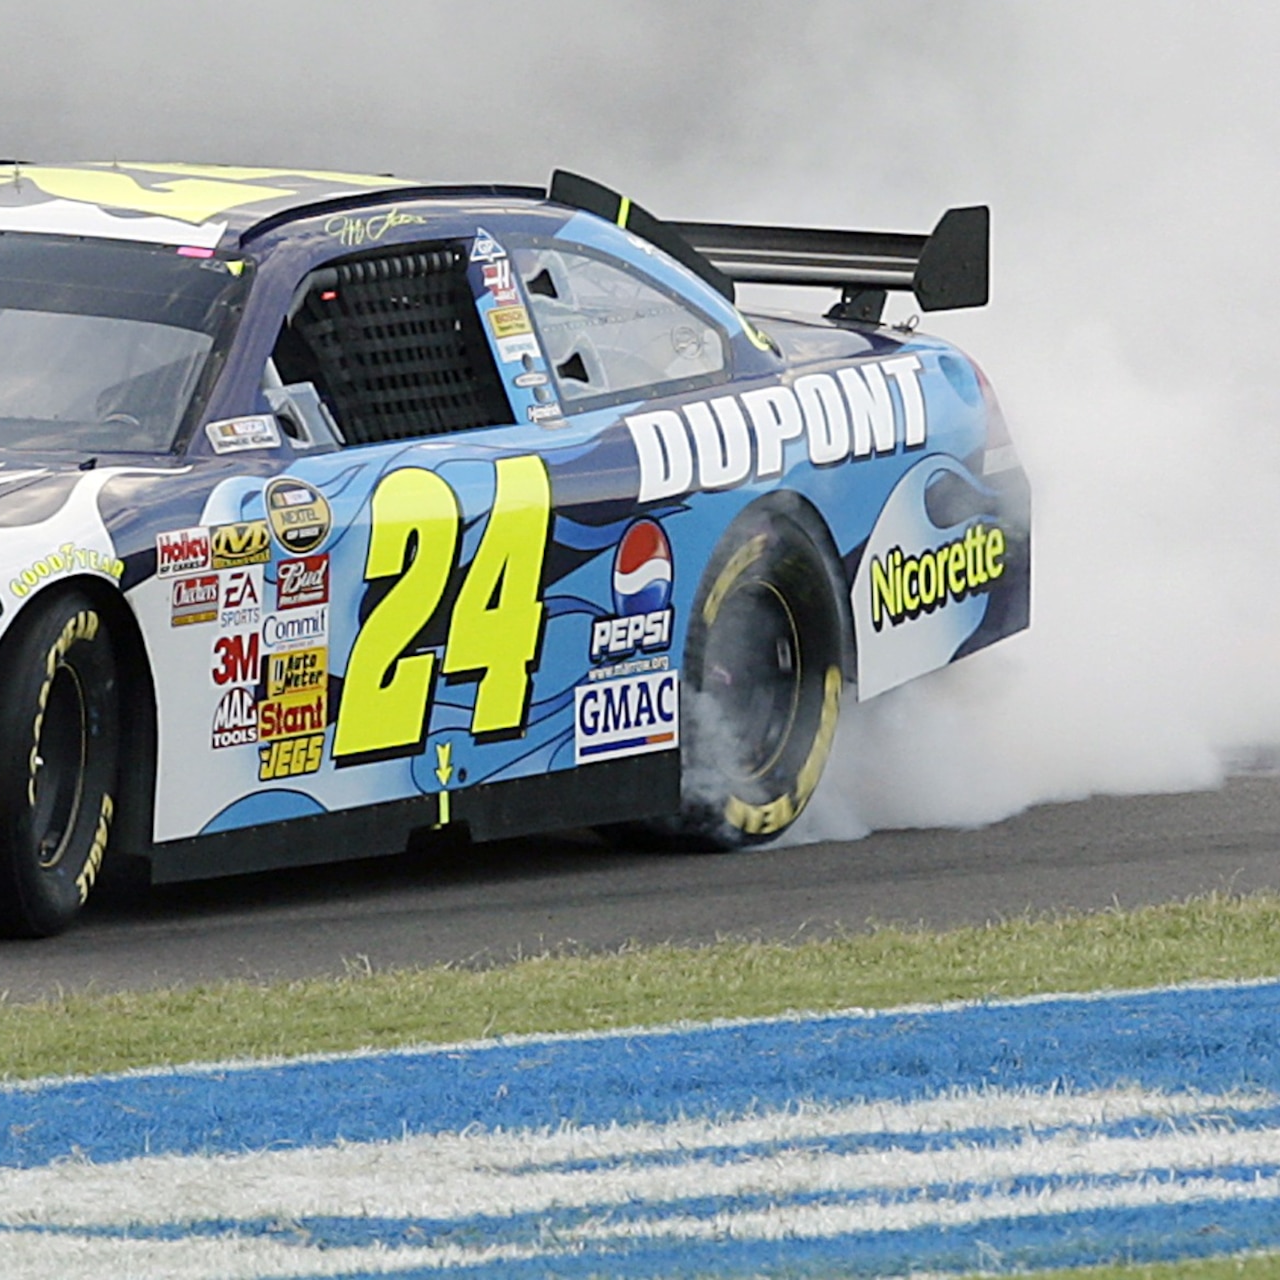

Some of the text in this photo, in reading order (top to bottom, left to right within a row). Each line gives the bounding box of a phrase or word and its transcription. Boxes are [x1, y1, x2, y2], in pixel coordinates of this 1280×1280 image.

[625, 355, 928, 503] DUPONT
[10, 542, 125, 597] GOODYEAR
[158, 531, 209, 568] Holley
[223, 572, 259, 609] EA
[278, 559, 327, 593] Bud
[871, 524, 1006, 632] Nicorette
[221, 608, 260, 628] SPORTS
[263, 607, 326, 648] Commit
[333, 455, 551, 757] 24
[592, 609, 671, 657] PEPSI
[212, 632, 259, 686] 3M
[214, 688, 257, 732] MAC
[260, 693, 324, 738] Stant
[579, 676, 674, 736] GMAC
[214, 727, 258, 747] TOOLS
[260, 735, 325, 781] JEGS
